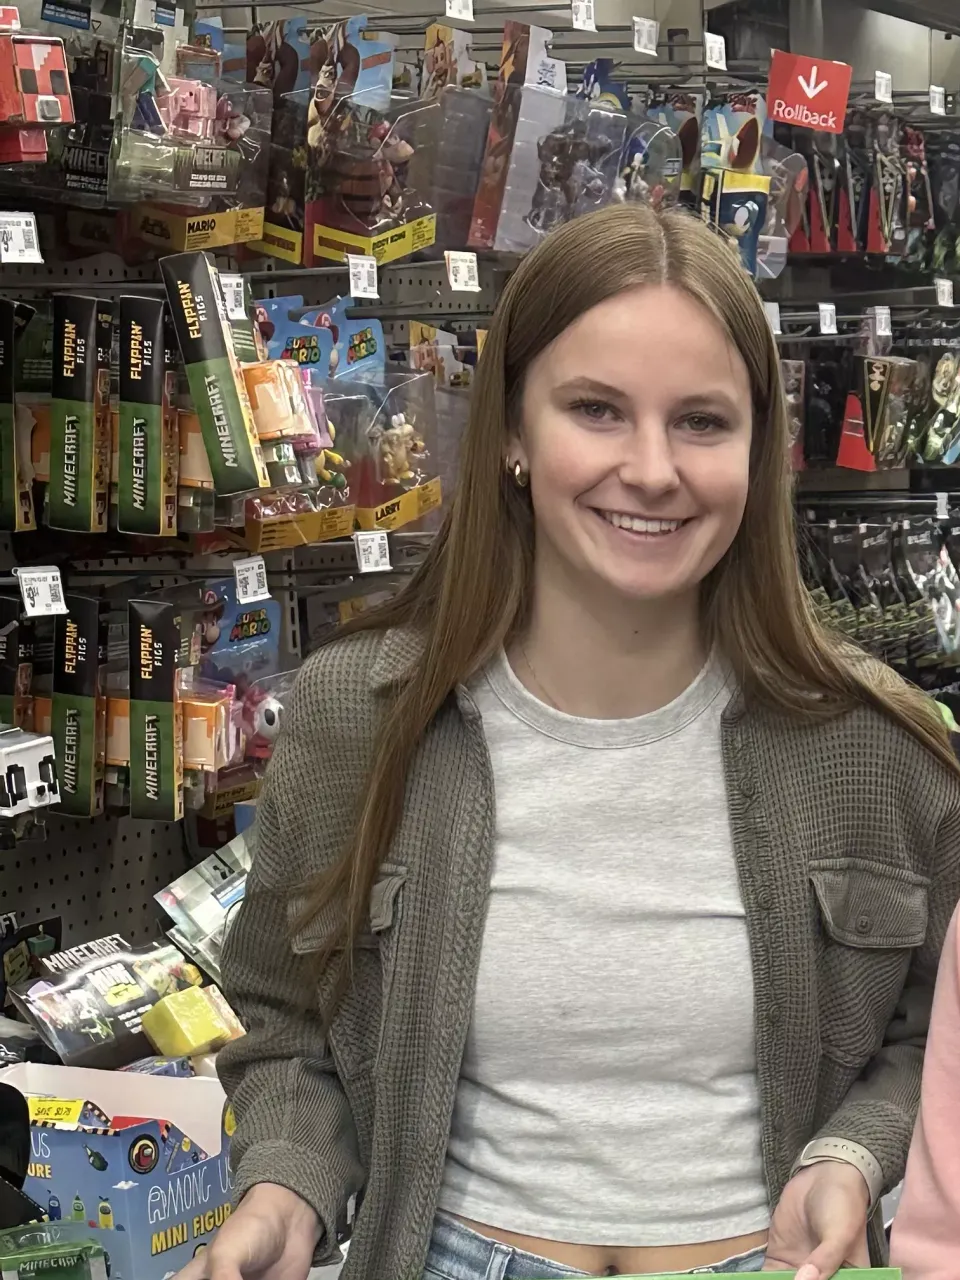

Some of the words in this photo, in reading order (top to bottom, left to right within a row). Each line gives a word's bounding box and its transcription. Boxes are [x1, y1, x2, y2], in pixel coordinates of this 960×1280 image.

[773, 99, 837, 129] Rollback
[187, 218, 216, 234] MARIO
[195, 295, 207, 322] FIGS
[76, 338, 86, 364] FIGS
[143, 340, 152, 366] FIGS
[281, 346, 321, 365] MARIO
[285, 335, 319, 350] SUPER
[204, 373, 238, 468] MINECRAFT
[63, 414, 80, 507] MINECRAFT
[132, 417, 148, 511] MINECRAFT
[375, 500, 401, 521] LARRY
[236, 608, 267, 625] SUPER
[229, 618, 271, 643] MARIO
[78, 637, 87, 662] FIGS
[153, 642, 163, 667] FIGS
[63, 707, 81, 794] MINECRAFT
[142, 714, 159, 801] MINECRAFT
[0, 911, 19, 938] FT
[40, 933, 132, 974] MINECRAFT
[148, 1164, 211, 1225] AMONG
[151, 1228, 189, 1257] MINI
[19, 1252, 88, 1273] MINECRAFT
